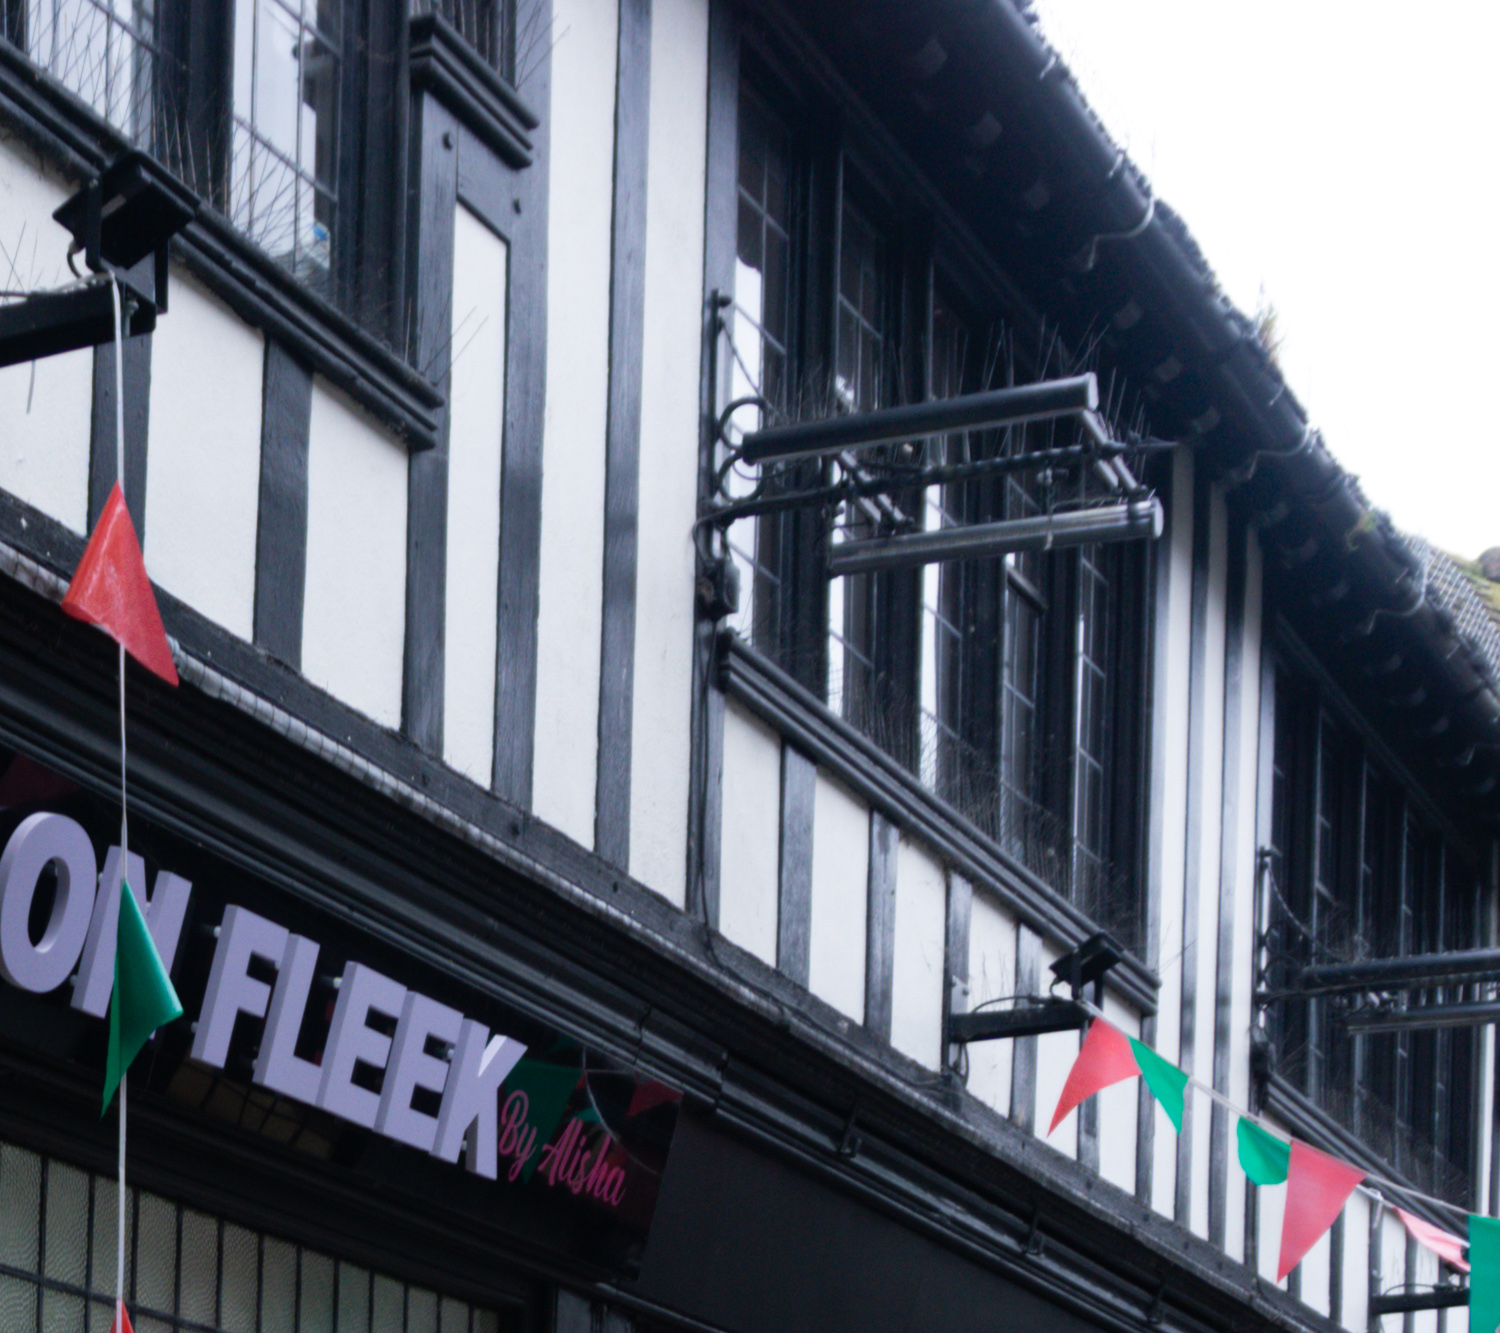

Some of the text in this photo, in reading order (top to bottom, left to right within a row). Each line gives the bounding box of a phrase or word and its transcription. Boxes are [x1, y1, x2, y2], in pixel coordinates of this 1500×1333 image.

[191, 904, 526, 1180] FLEEK
[499, 1089, 627, 1207] By Alisha
